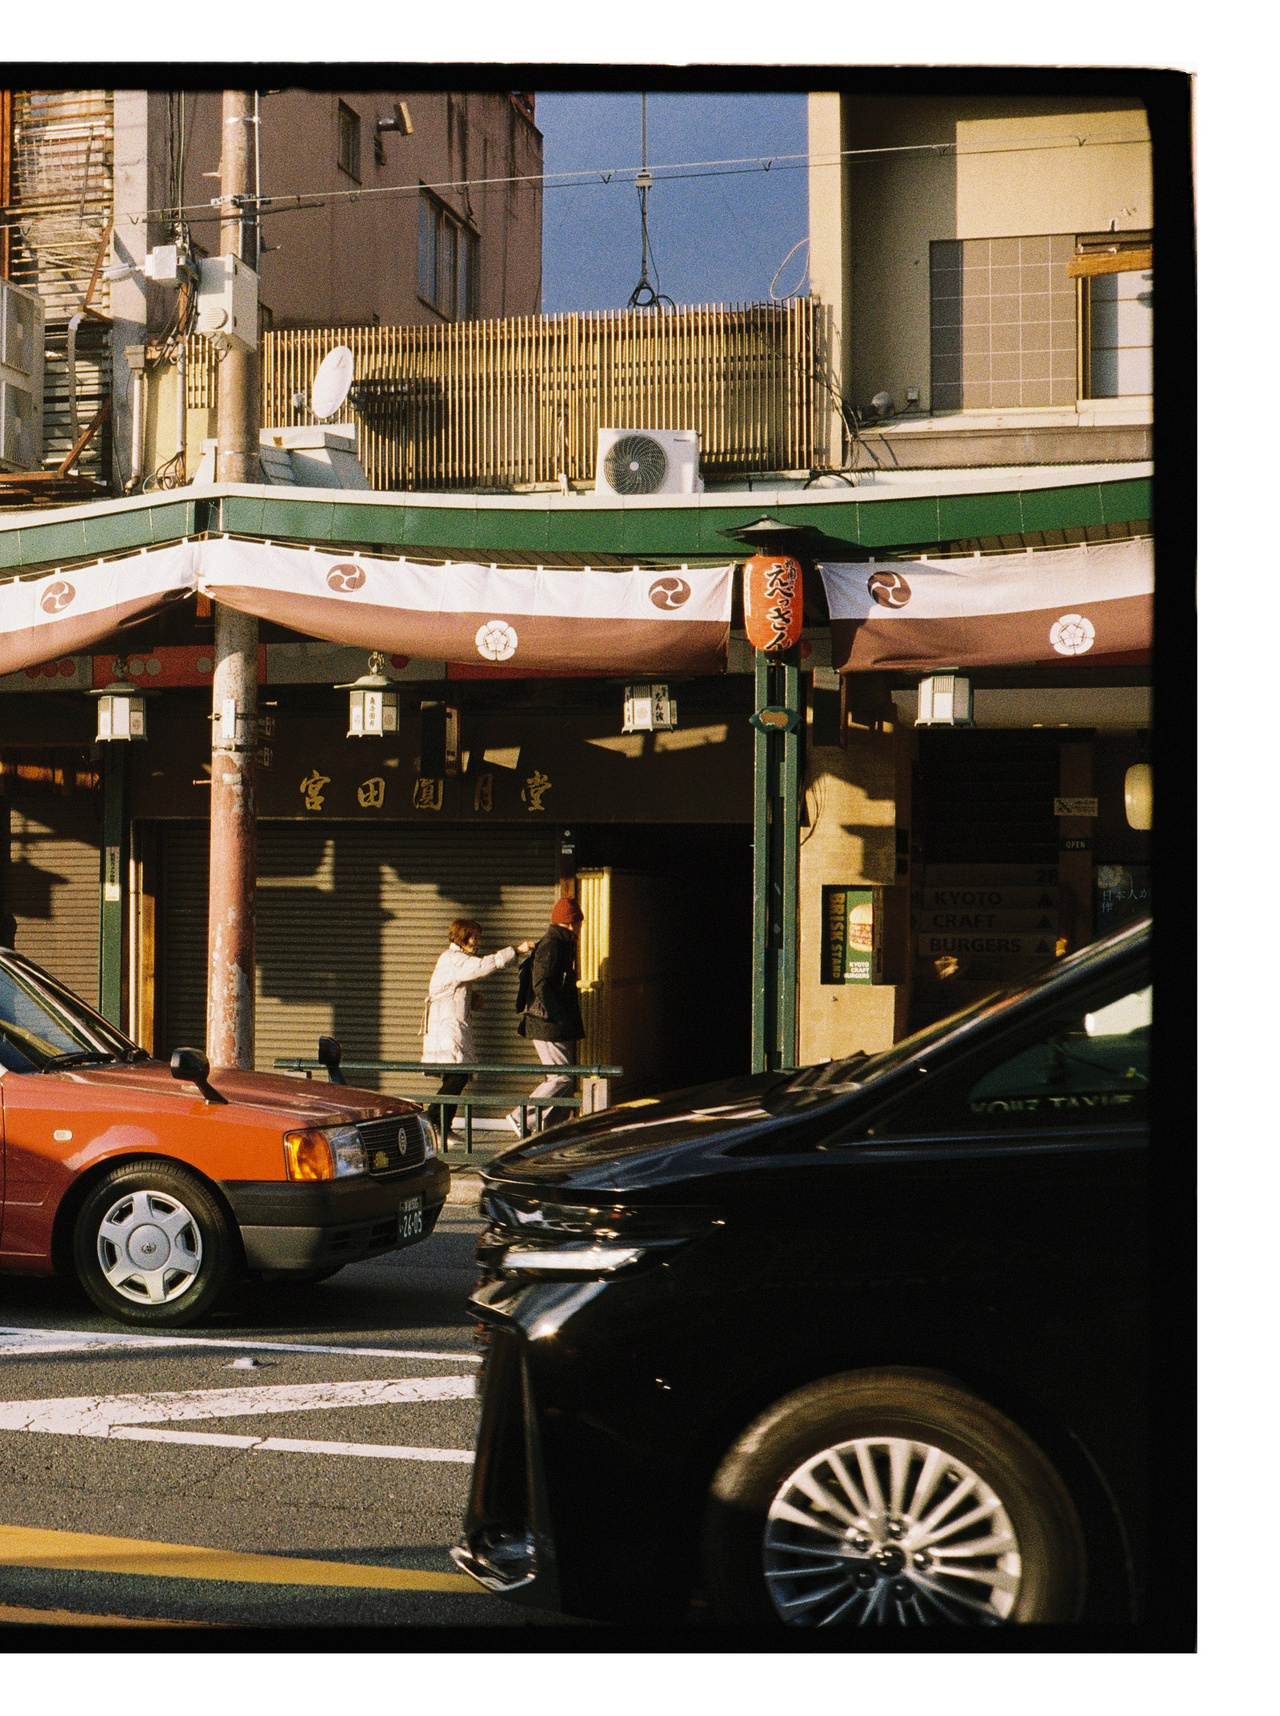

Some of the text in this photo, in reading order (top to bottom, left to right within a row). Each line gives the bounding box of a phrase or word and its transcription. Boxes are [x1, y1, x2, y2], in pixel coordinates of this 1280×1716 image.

[1065, 840, 1086, 849] OPEN
[934, 890, 1003, 906] KYOTO
[829, 892, 845, 941] BRISK
[932, 913, 996, 929] CRAFT
[929, 937, 1021, 953] BURGERS
